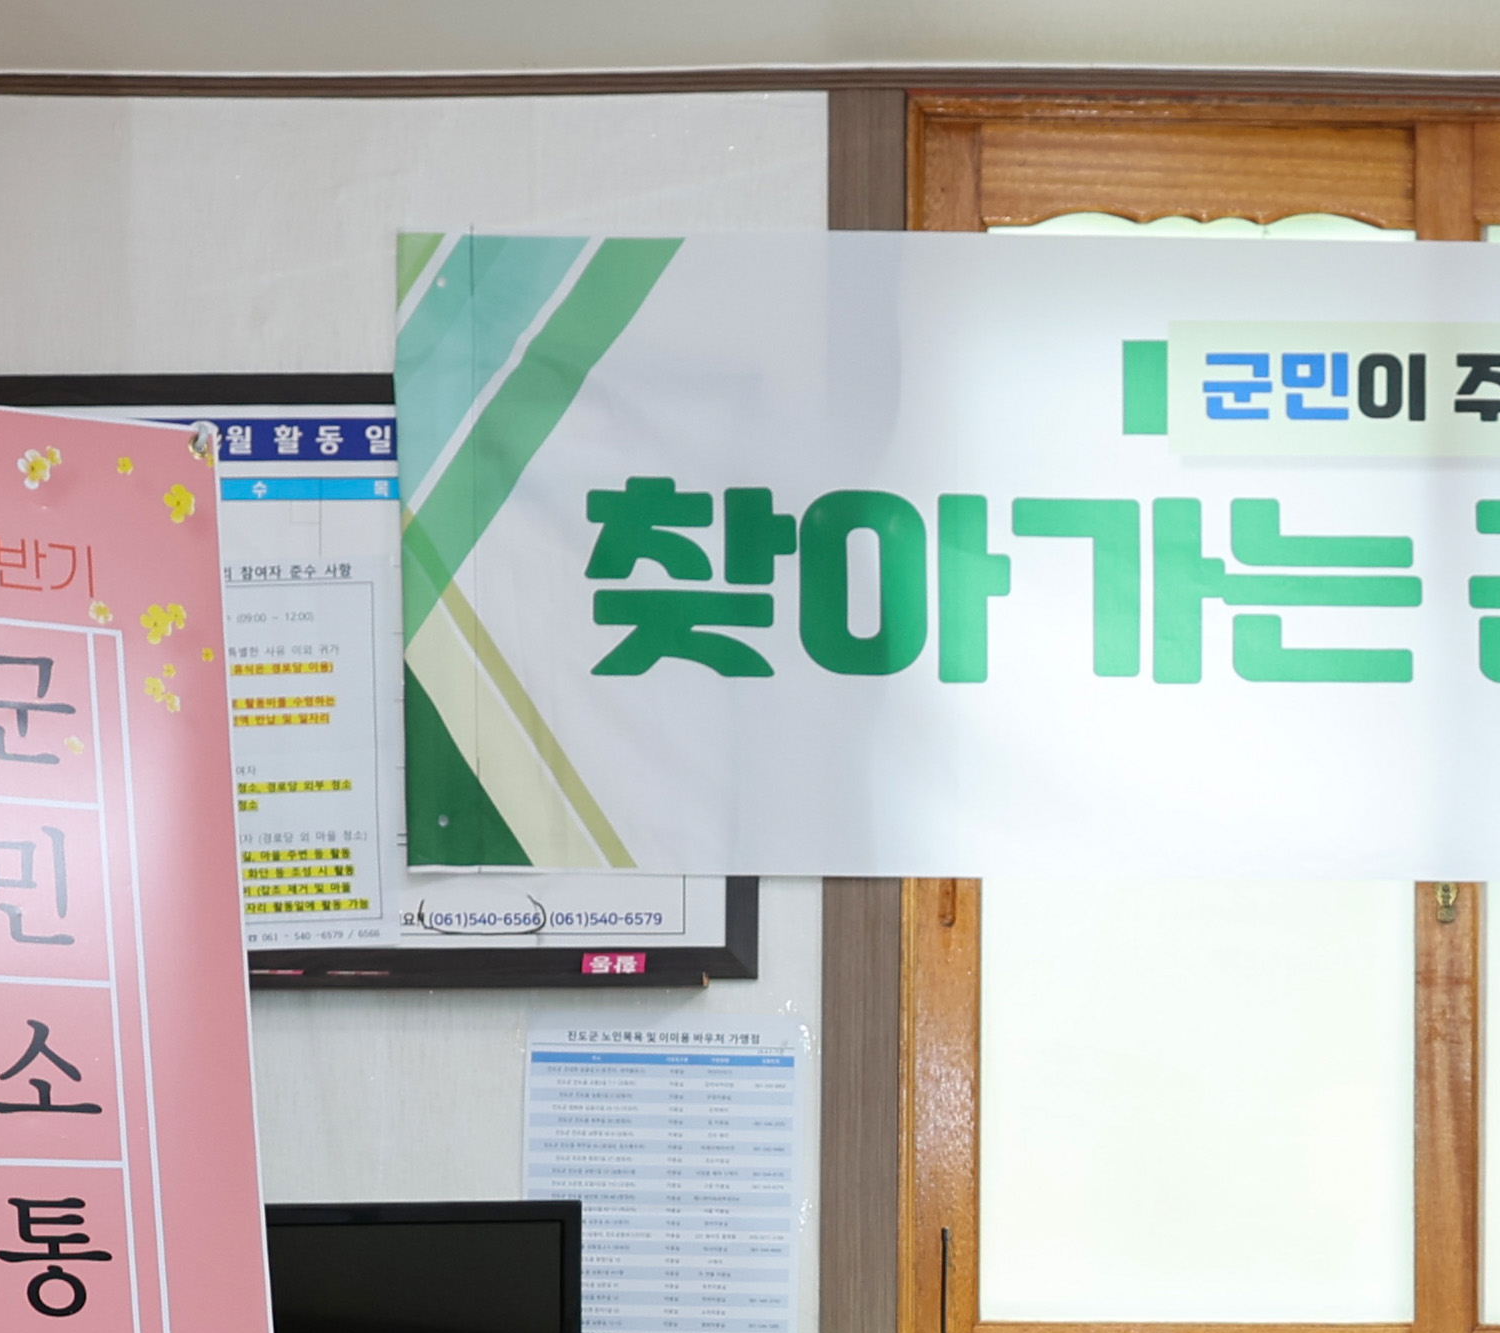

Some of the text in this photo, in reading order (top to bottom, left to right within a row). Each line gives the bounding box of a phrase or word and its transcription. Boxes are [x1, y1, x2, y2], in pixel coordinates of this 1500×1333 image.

[1203, 353, 1427, 422] 군민이
[251, 480, 268, 498] 수
[585, 477, 1423, 685] 찾아가는
[428, 911, 542, 927] (061)540-6566
[549, 911, 664, 927] (061)540-6579
[567, 1030, 599, 1043] 진도군
